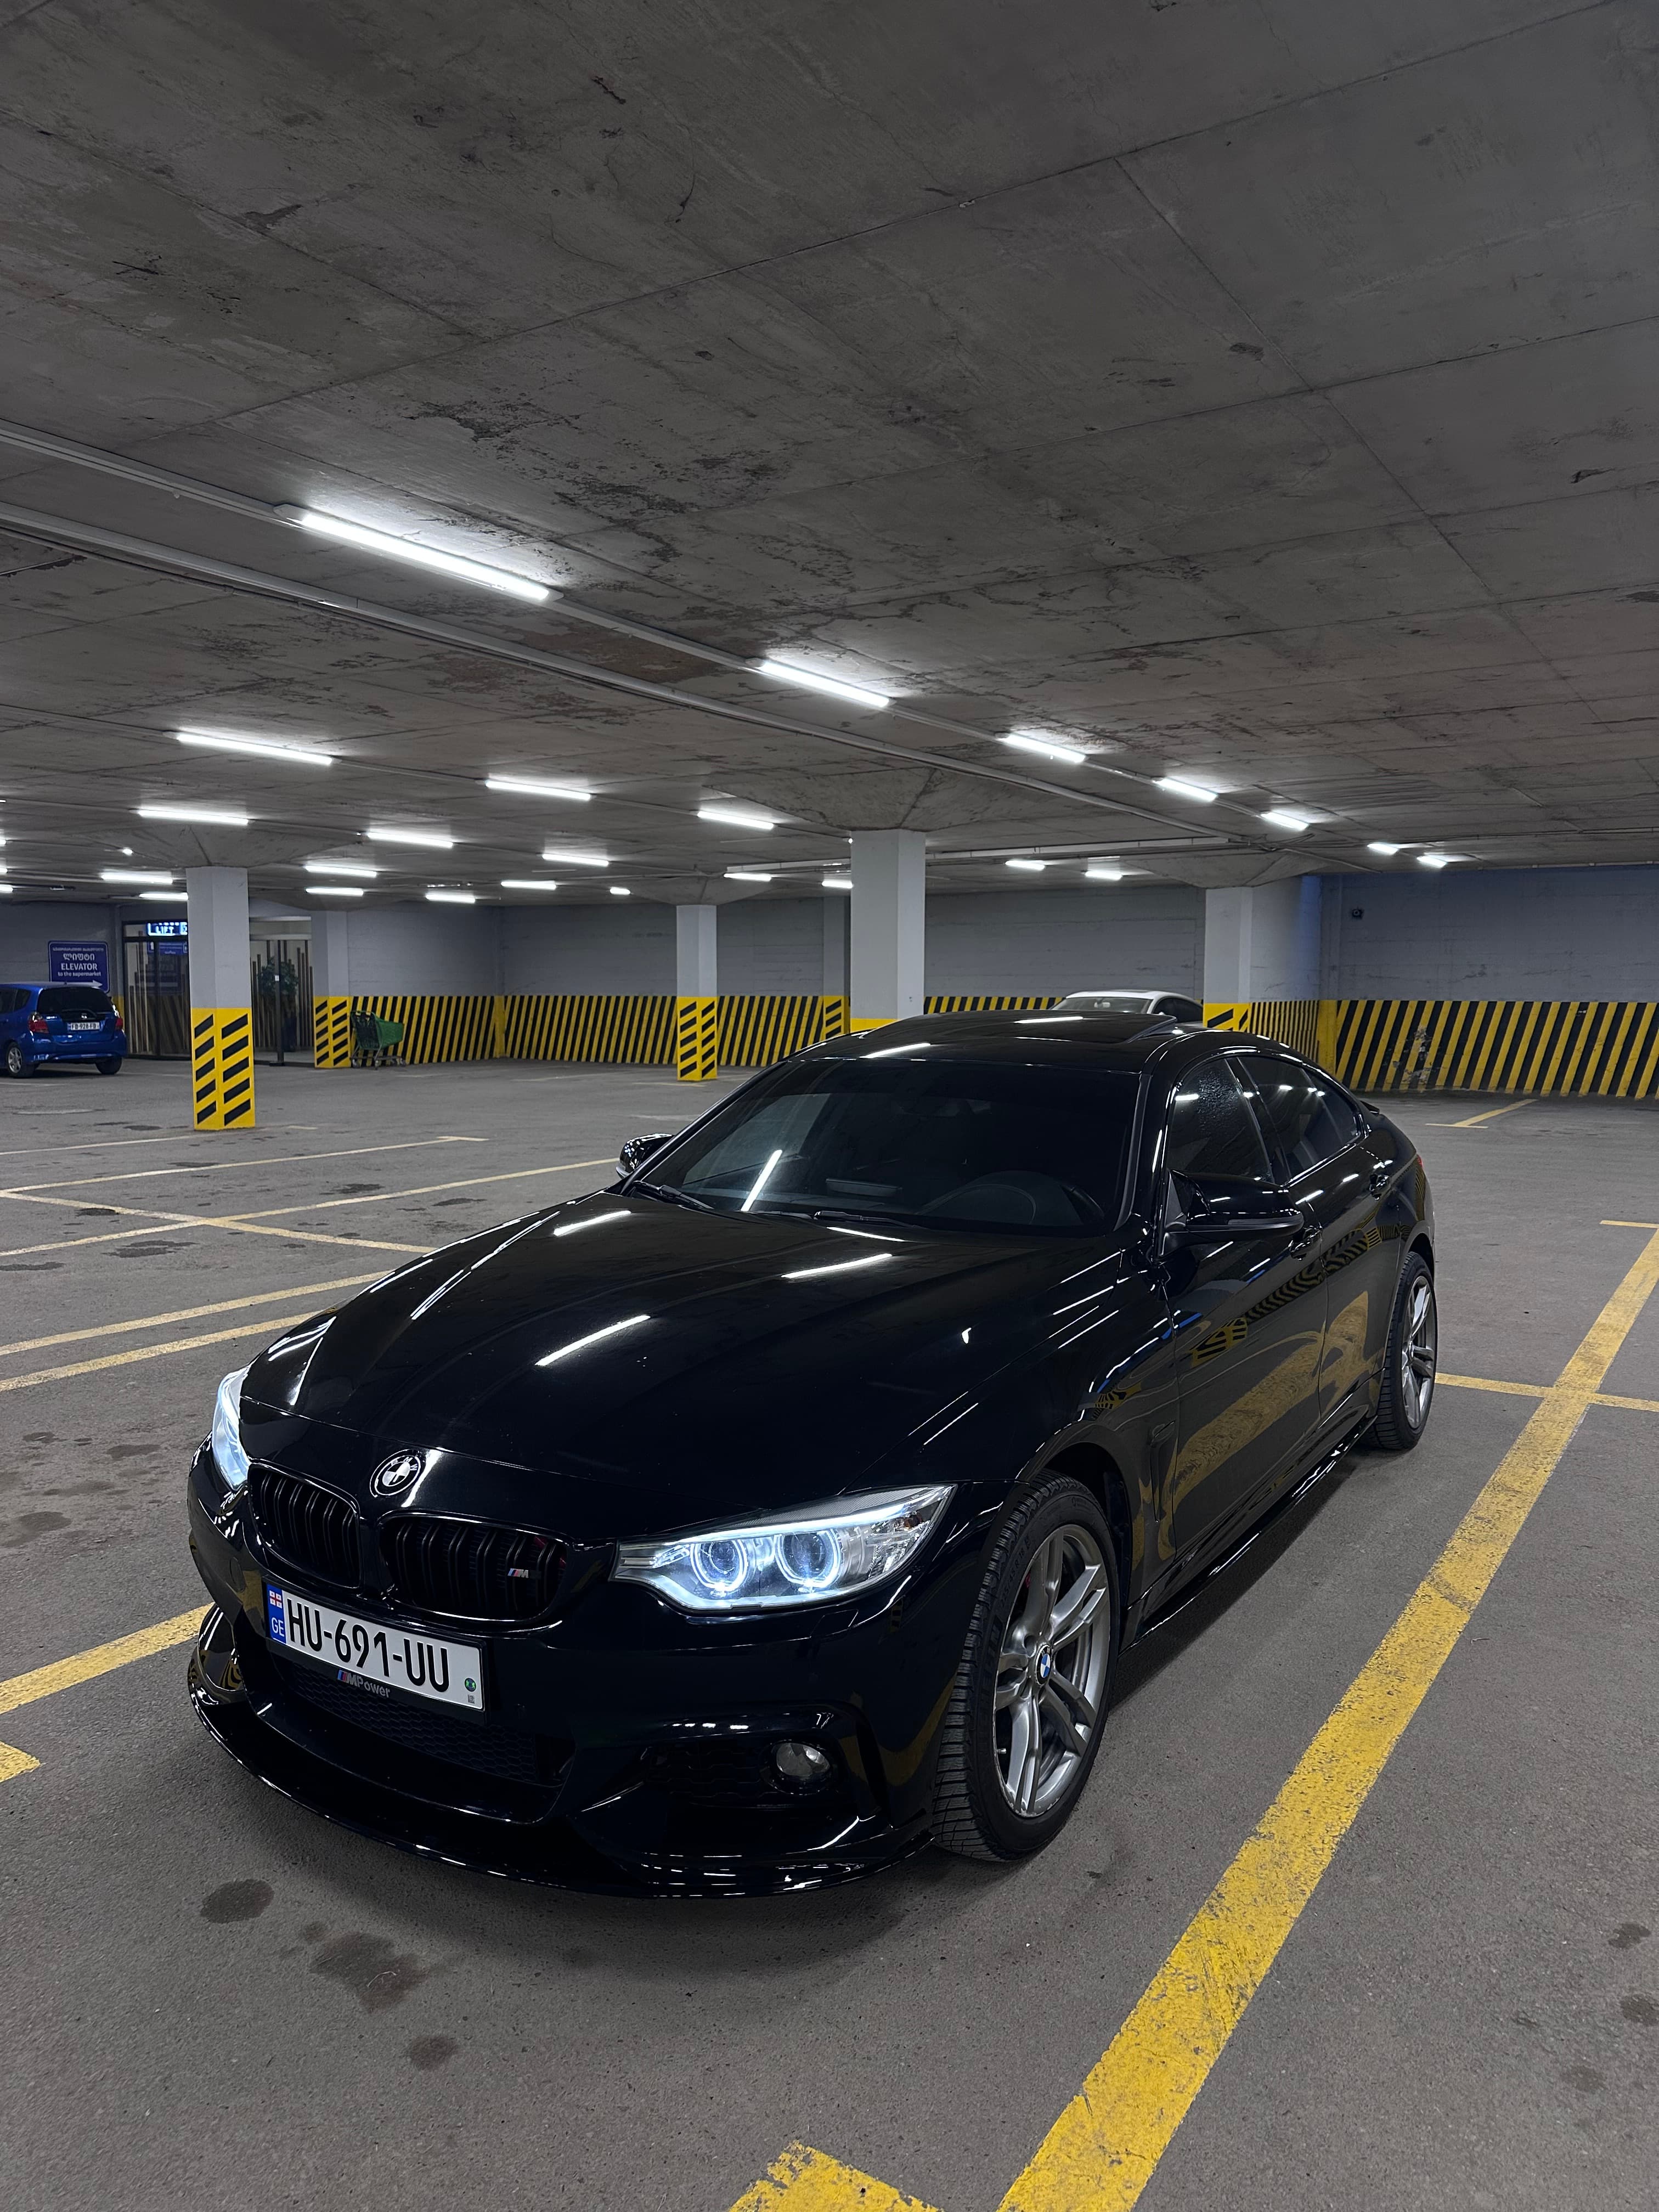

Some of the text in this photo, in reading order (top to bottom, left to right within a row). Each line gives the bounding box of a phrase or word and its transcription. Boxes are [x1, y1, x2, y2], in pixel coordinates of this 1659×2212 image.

[391, 1456, 419, 1471] BMW
[515, 1569, 529, 1579] M
[272, 1617, 285, 1637] GE
[287, 1598, 450, 1693] HU-691-UU
